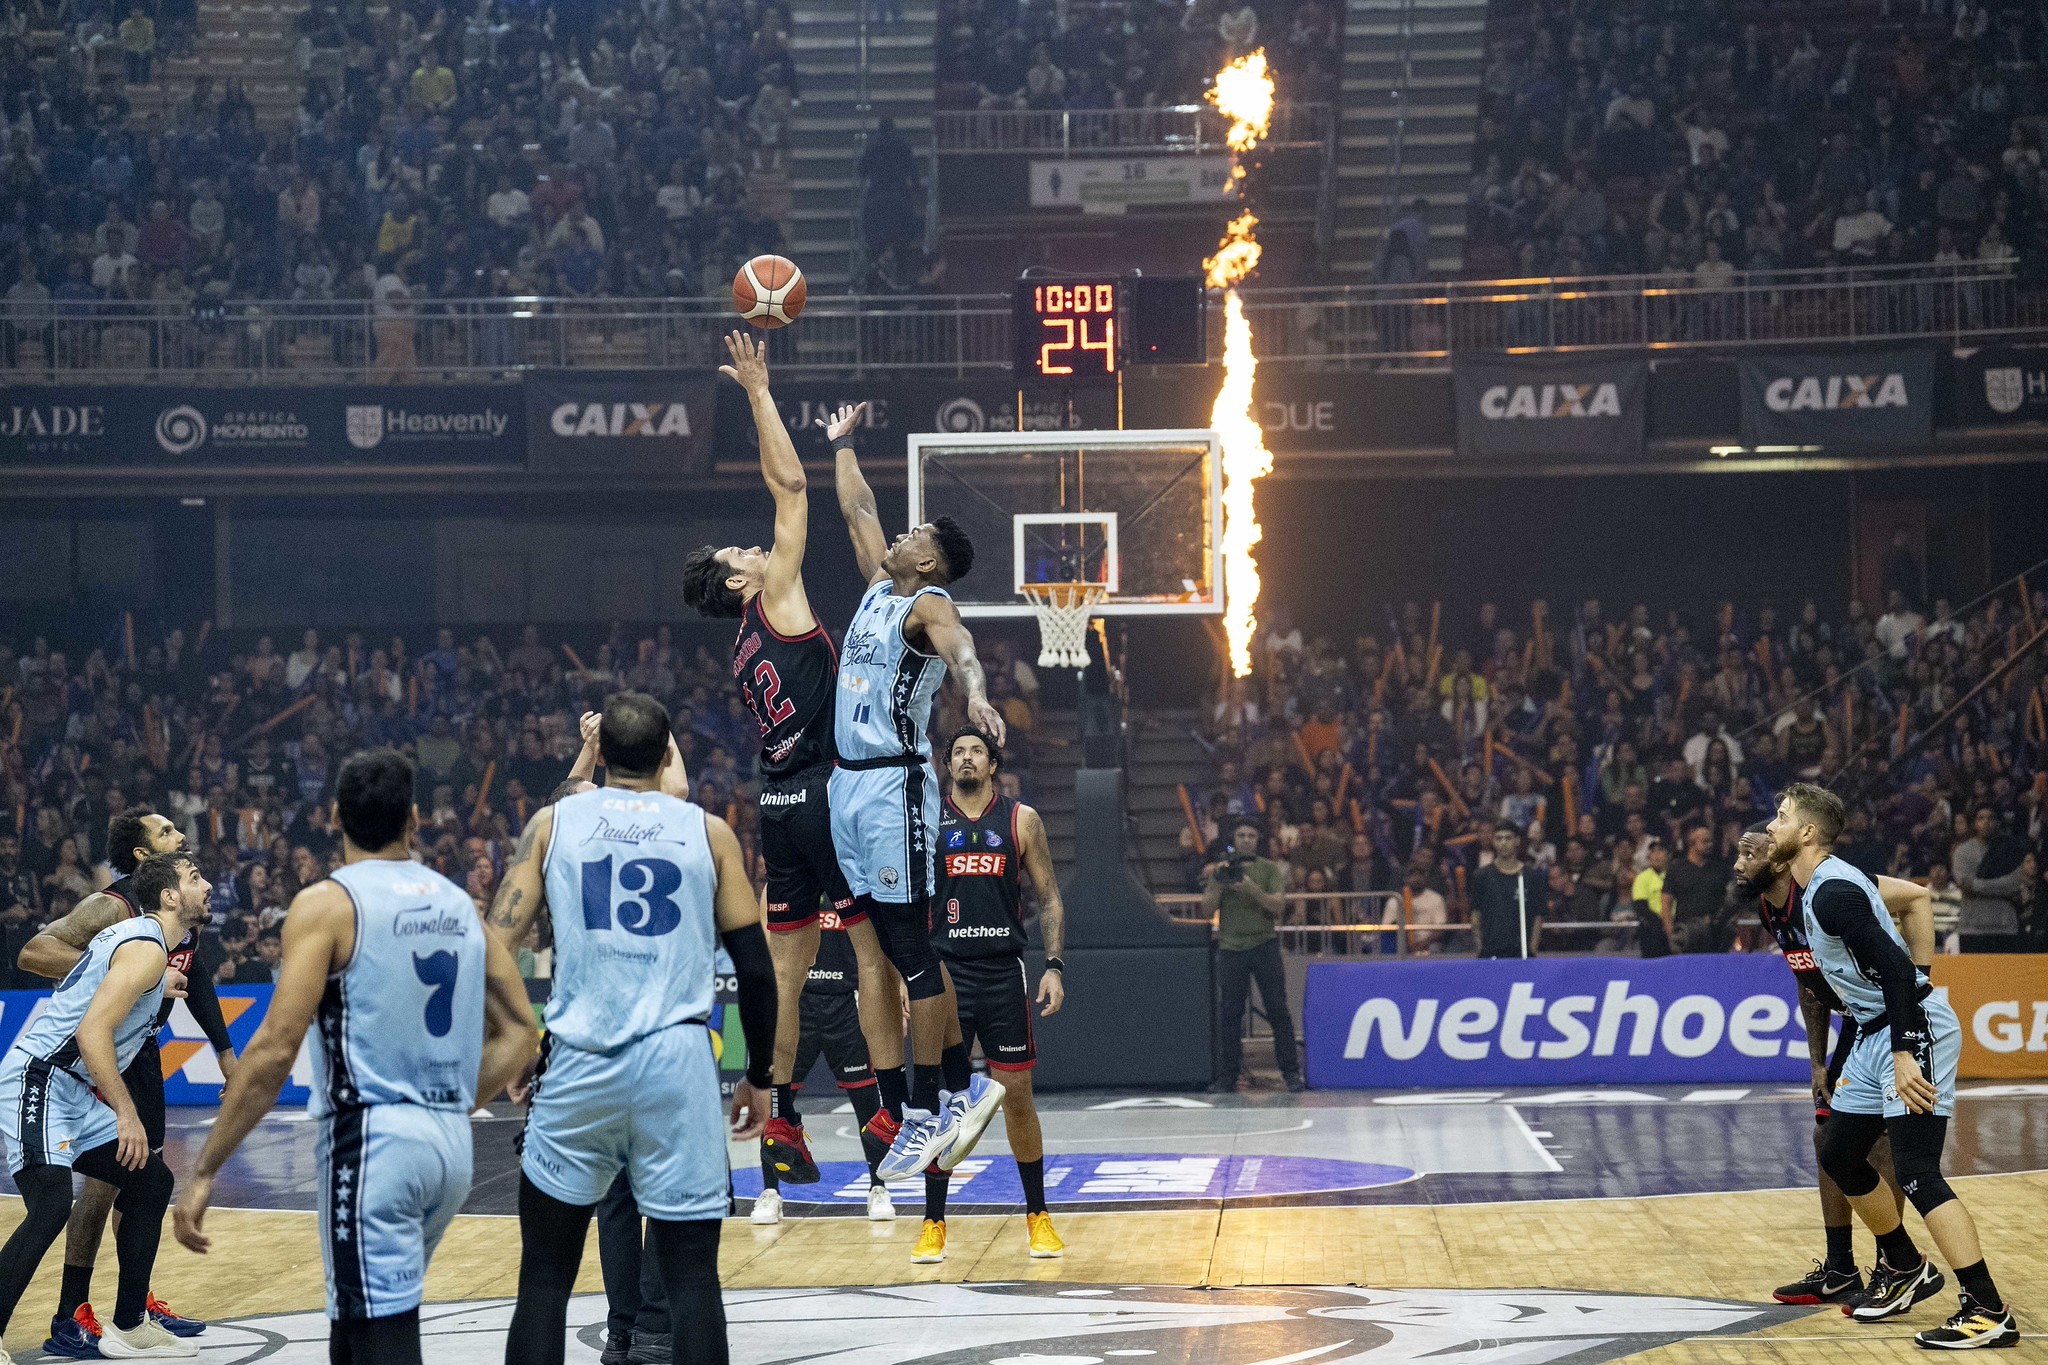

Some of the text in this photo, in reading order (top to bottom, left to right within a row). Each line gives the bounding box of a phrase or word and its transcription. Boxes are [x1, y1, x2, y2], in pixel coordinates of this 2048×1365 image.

[1034, 284, 1113, 313] 10:00
[1041, 317, 1115, 375] 24
[1480, 383, 1622, 419] CAIXA
[1764, 373, 1909, 412] CAIXA
[0, 405, 105, 437] JADE
[387, 408, 508, 436] Heavenly
[551, 403, 692, 437] CAIXA
[743, 660, 796, 738] 12
[853, 702, 871, 725] 11
[952, 855, 1001, 875] SESI
[581, 853, 682, 937] 13
[834, 898, 851, 910] SESI
[947, 898, 960, 924] 9
[167, 953, 191, 972] SI
[806, 969, 844, 980] tshoes
[1787, 951, 1818, 970] SES
[412, 949, 459, 1038] 7
[999, 1044, 1027, 1053] Unimed
[844, 1064, 868, 1073] Unimed
